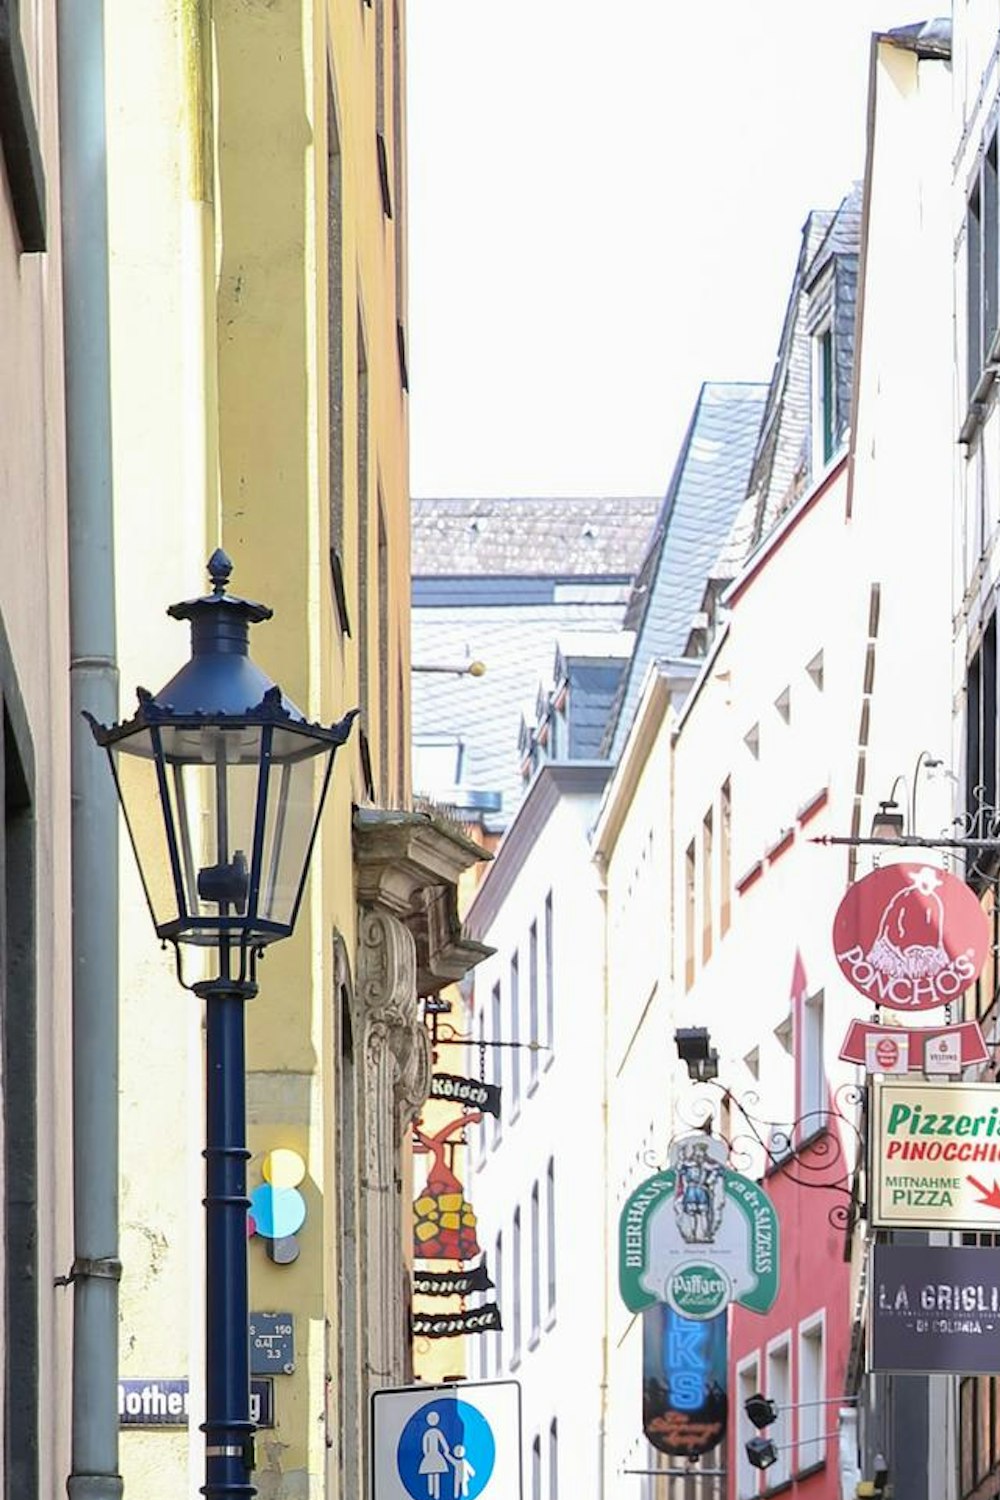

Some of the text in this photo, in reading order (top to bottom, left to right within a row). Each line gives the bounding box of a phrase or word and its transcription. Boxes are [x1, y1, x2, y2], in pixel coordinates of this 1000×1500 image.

[885, 1176, 962, 1190] MITNAHME
[892, 1189, 954, 1207] PIZZA
[626, 1179, 673, 1268] BIERHAUS
[879, 1284, 909, 1310] LA
